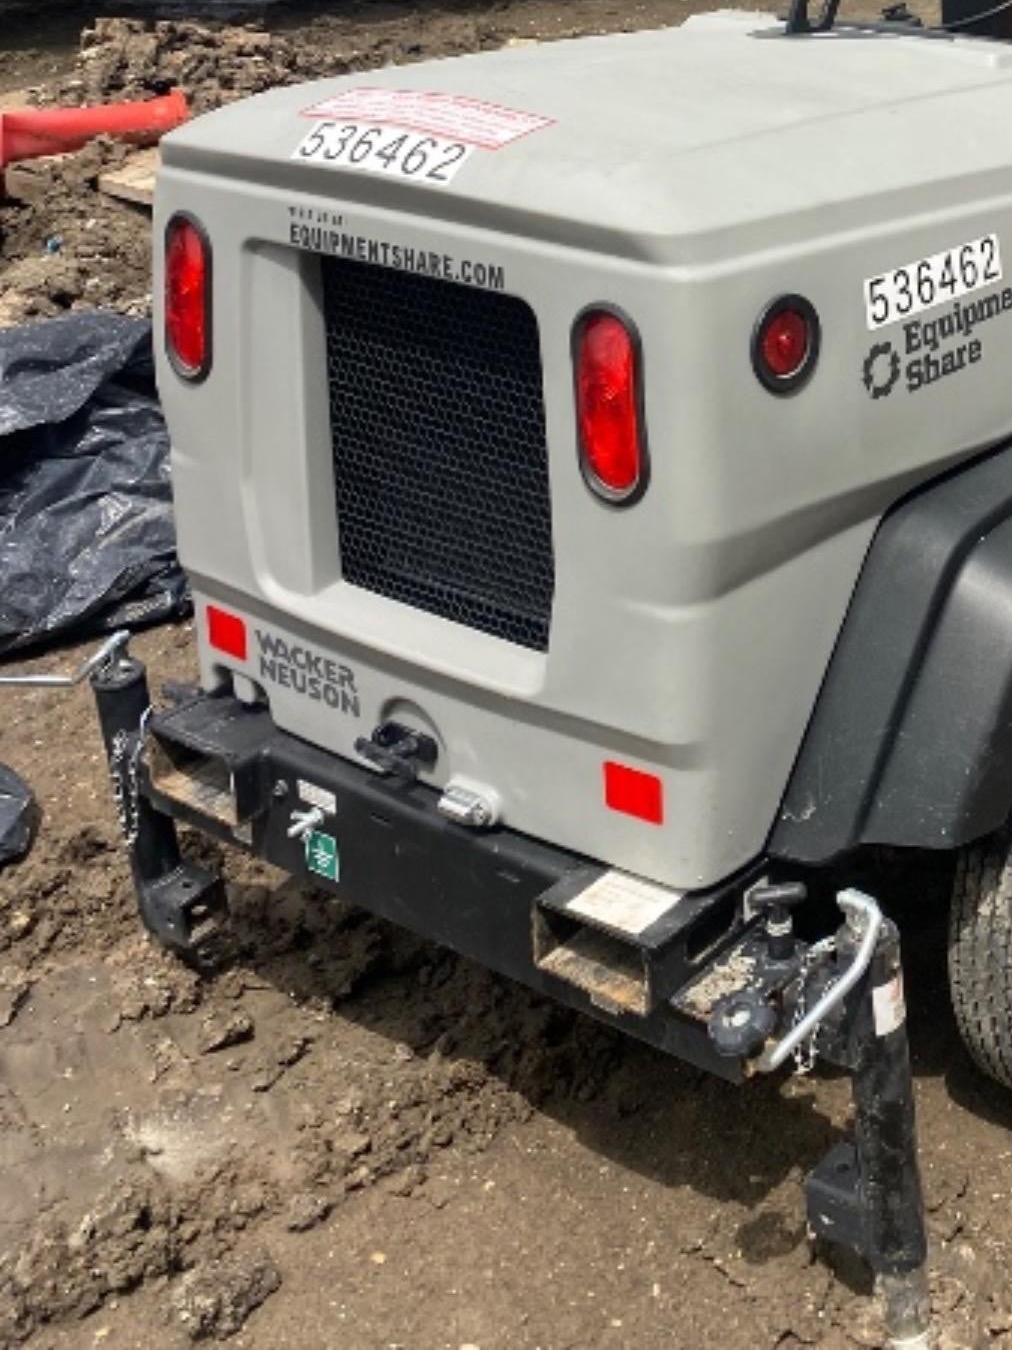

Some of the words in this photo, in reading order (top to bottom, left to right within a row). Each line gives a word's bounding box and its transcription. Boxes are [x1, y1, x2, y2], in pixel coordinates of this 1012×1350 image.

[300, 122, 467, 181] 536462
[290, 223, 505, 290] EQUIPMENTSHARE.COM
[869, 237, 999, 324] 536462
[906, 338, 983, 393] Share
[254, 629, 358, 694] WACKER
[260, 655, 361, 718] NEUSON
